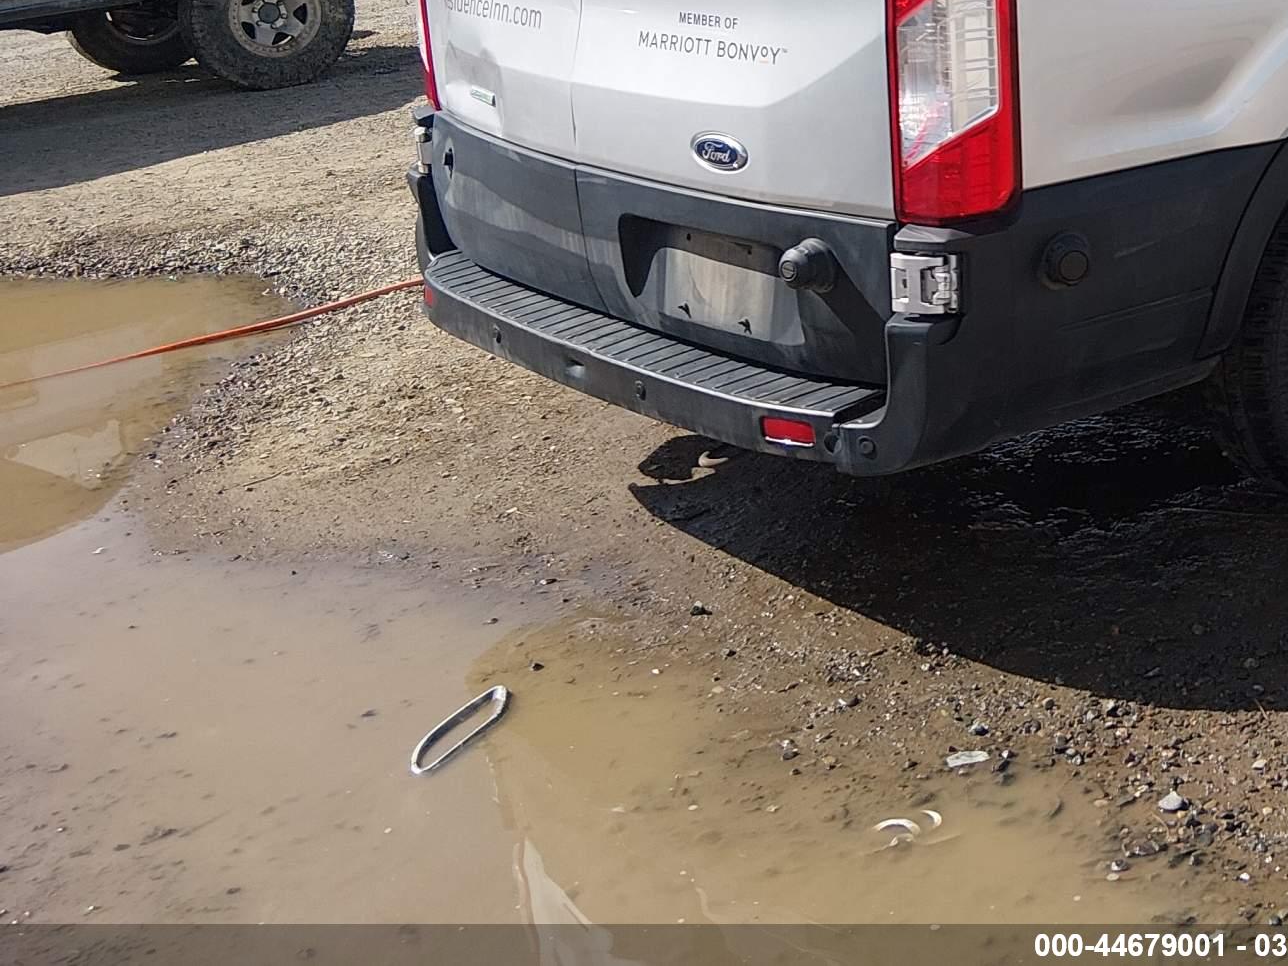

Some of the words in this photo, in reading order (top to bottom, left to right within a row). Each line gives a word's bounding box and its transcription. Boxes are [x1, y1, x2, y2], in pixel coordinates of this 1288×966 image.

[678, 11, 721, 29] MEMBER
[724, 17, 739, 30] OF
[638, 30, 712, 57] MARRIOTT
[702, 141, 731, 163] Ford
